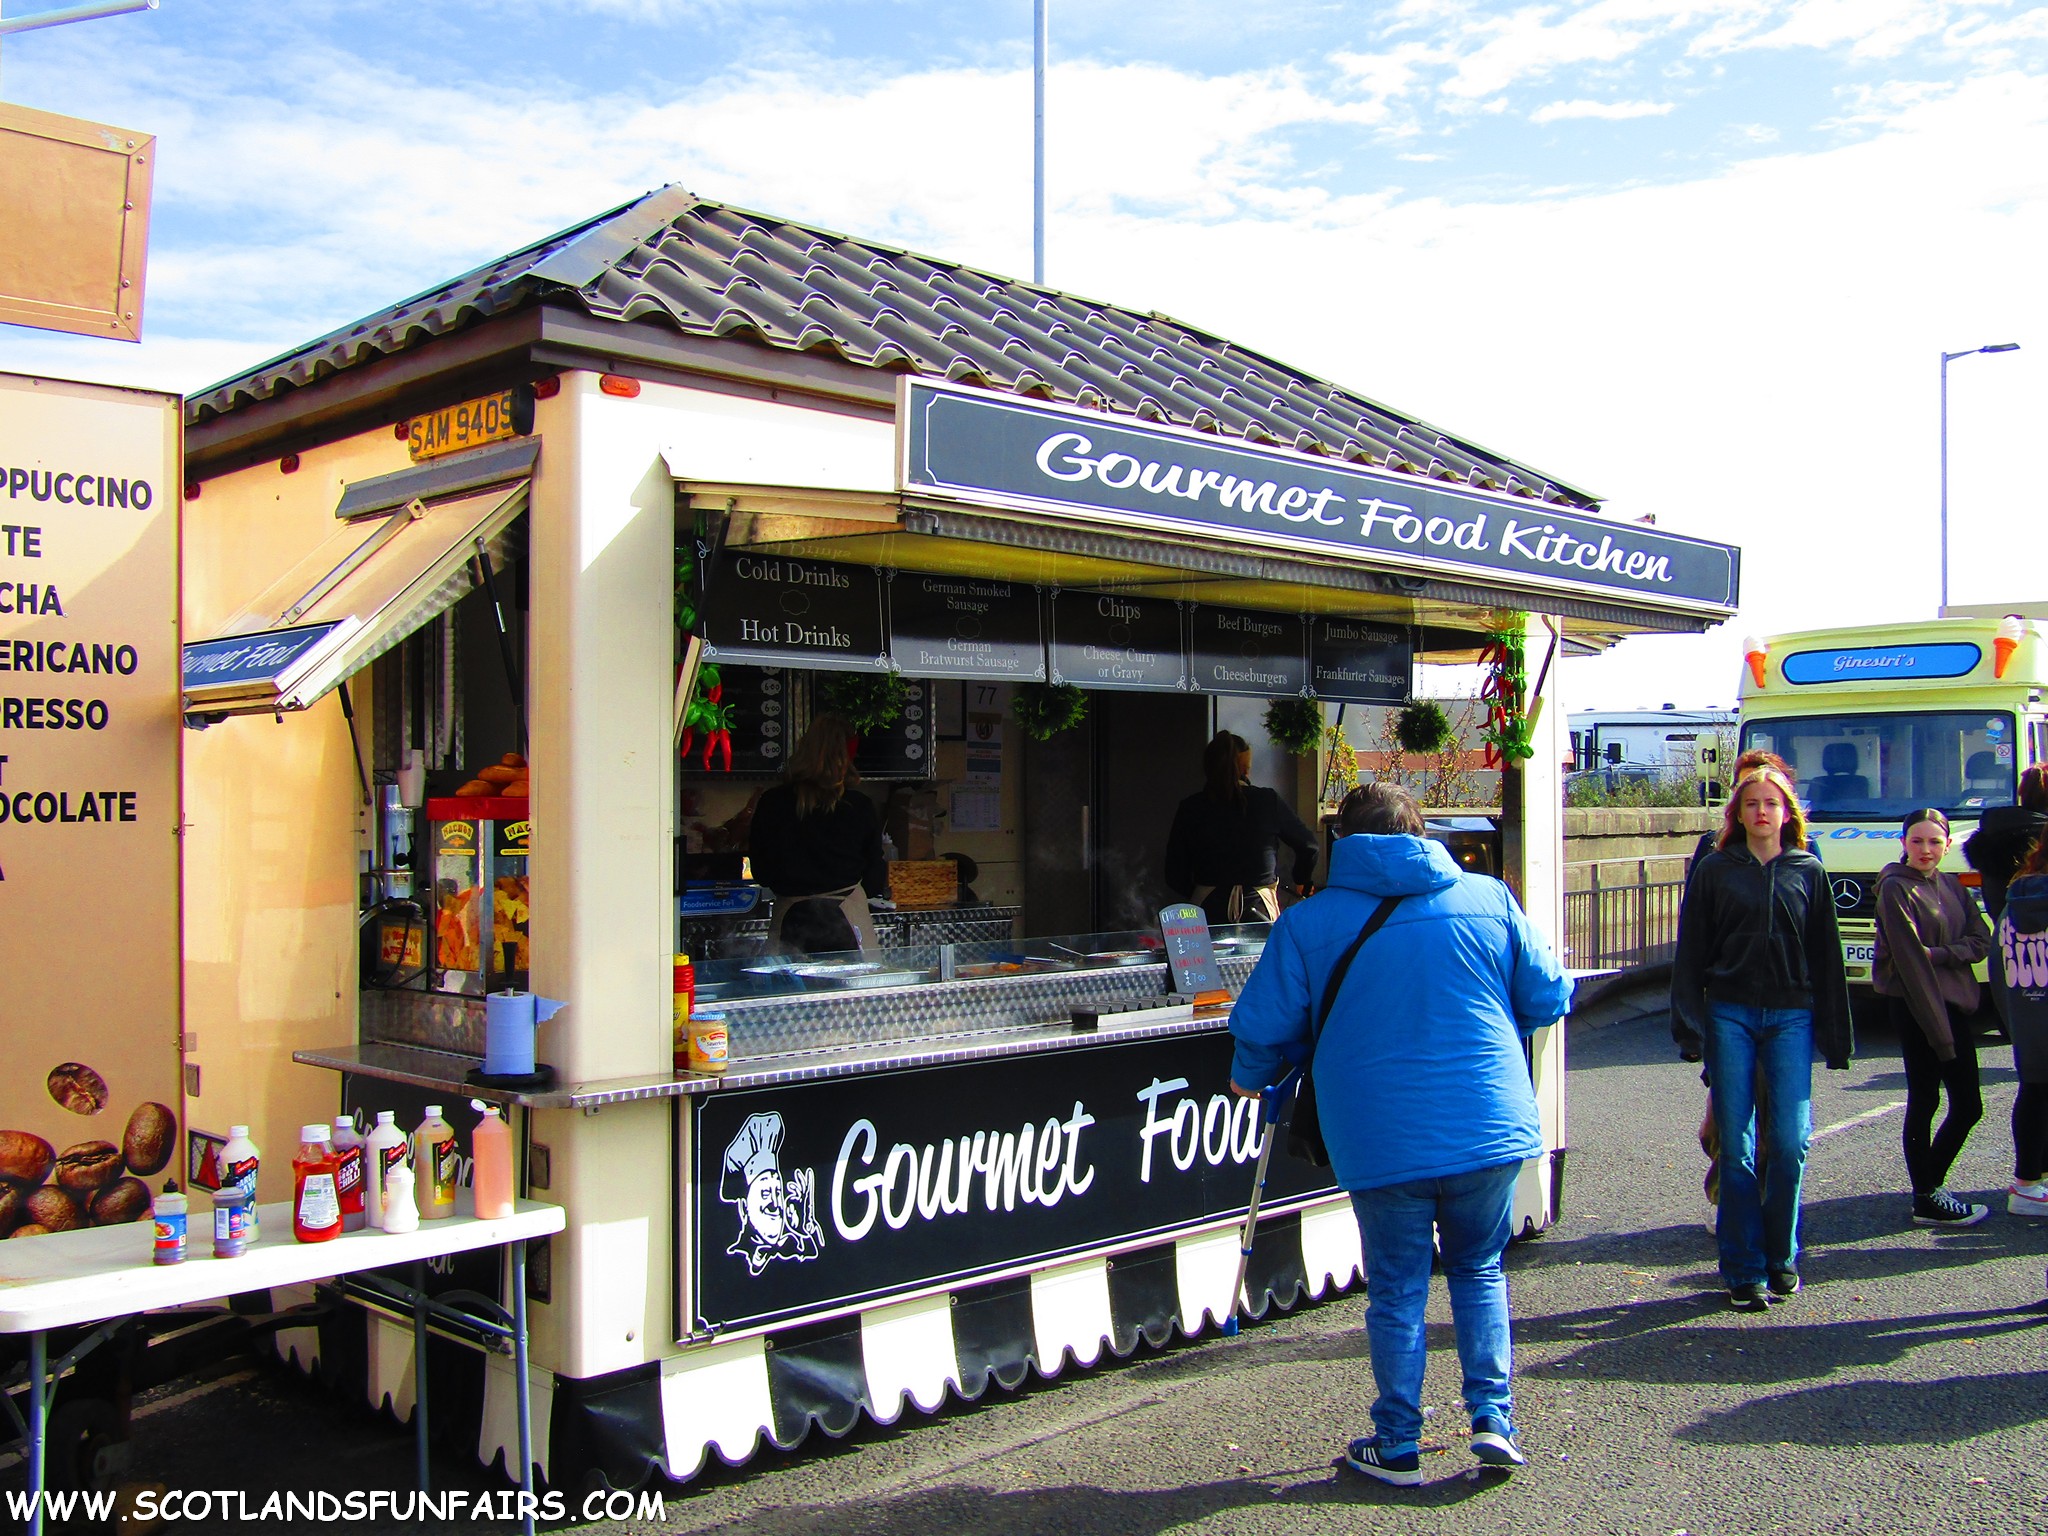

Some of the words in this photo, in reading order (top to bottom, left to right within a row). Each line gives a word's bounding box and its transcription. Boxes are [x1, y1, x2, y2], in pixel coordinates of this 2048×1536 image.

[409, 412, 449, 453] SAM
[1035, 432, 1347, 526] Gourmet
[1357, 497, 1489, 552] Food
[1499, 519, 1673, 583] Kitchen
[736, 557, 781, 581] Cold
[787, 563, 850, 589] Drinks
[922, 578, 966, 596] German
[968, 582, 1011, 598] Smoked
[947, 597, 989, 614] Sausage
[1098, 597, 1141, 624] Chips
[741, 618, 780, 642] Hot
[785, 623, 851, 648] Drinks
[1217, 614, 1241, 630] Beef
[1243, 617, 1282, 637] Burgers
[1325, 622, 1359, 641] Jumbo
[1361, 626, 1398, 645] Sausage
[231, 636, 313, 672] Food
[947, 637, 991, 653] German
[1083, 645, 1124, 663] Cheese,
[1127, 648, 1156, 666] Curry
[920, 650, 974, 667] Bratwurst
[976, 653, 1019, 670] Sausage
[1833, 653, 1916, 672] Ginestri's
[1098, 667, 1110, 678] or
[1112, 664, 1144, 682] Gravy
[1214, 665, 1287, 685] Cheeseburgers
[1315, 665, 1367, 682] Frankfurter
[1368, 668, 1405, 686] Sausages
[977, 686, 997, 705] 77
[683, 900, 721, 909] Foodservice
[831, 1099, 1096, 1242] Gourmet
[1136, 1076, 1266, 1184] Food
